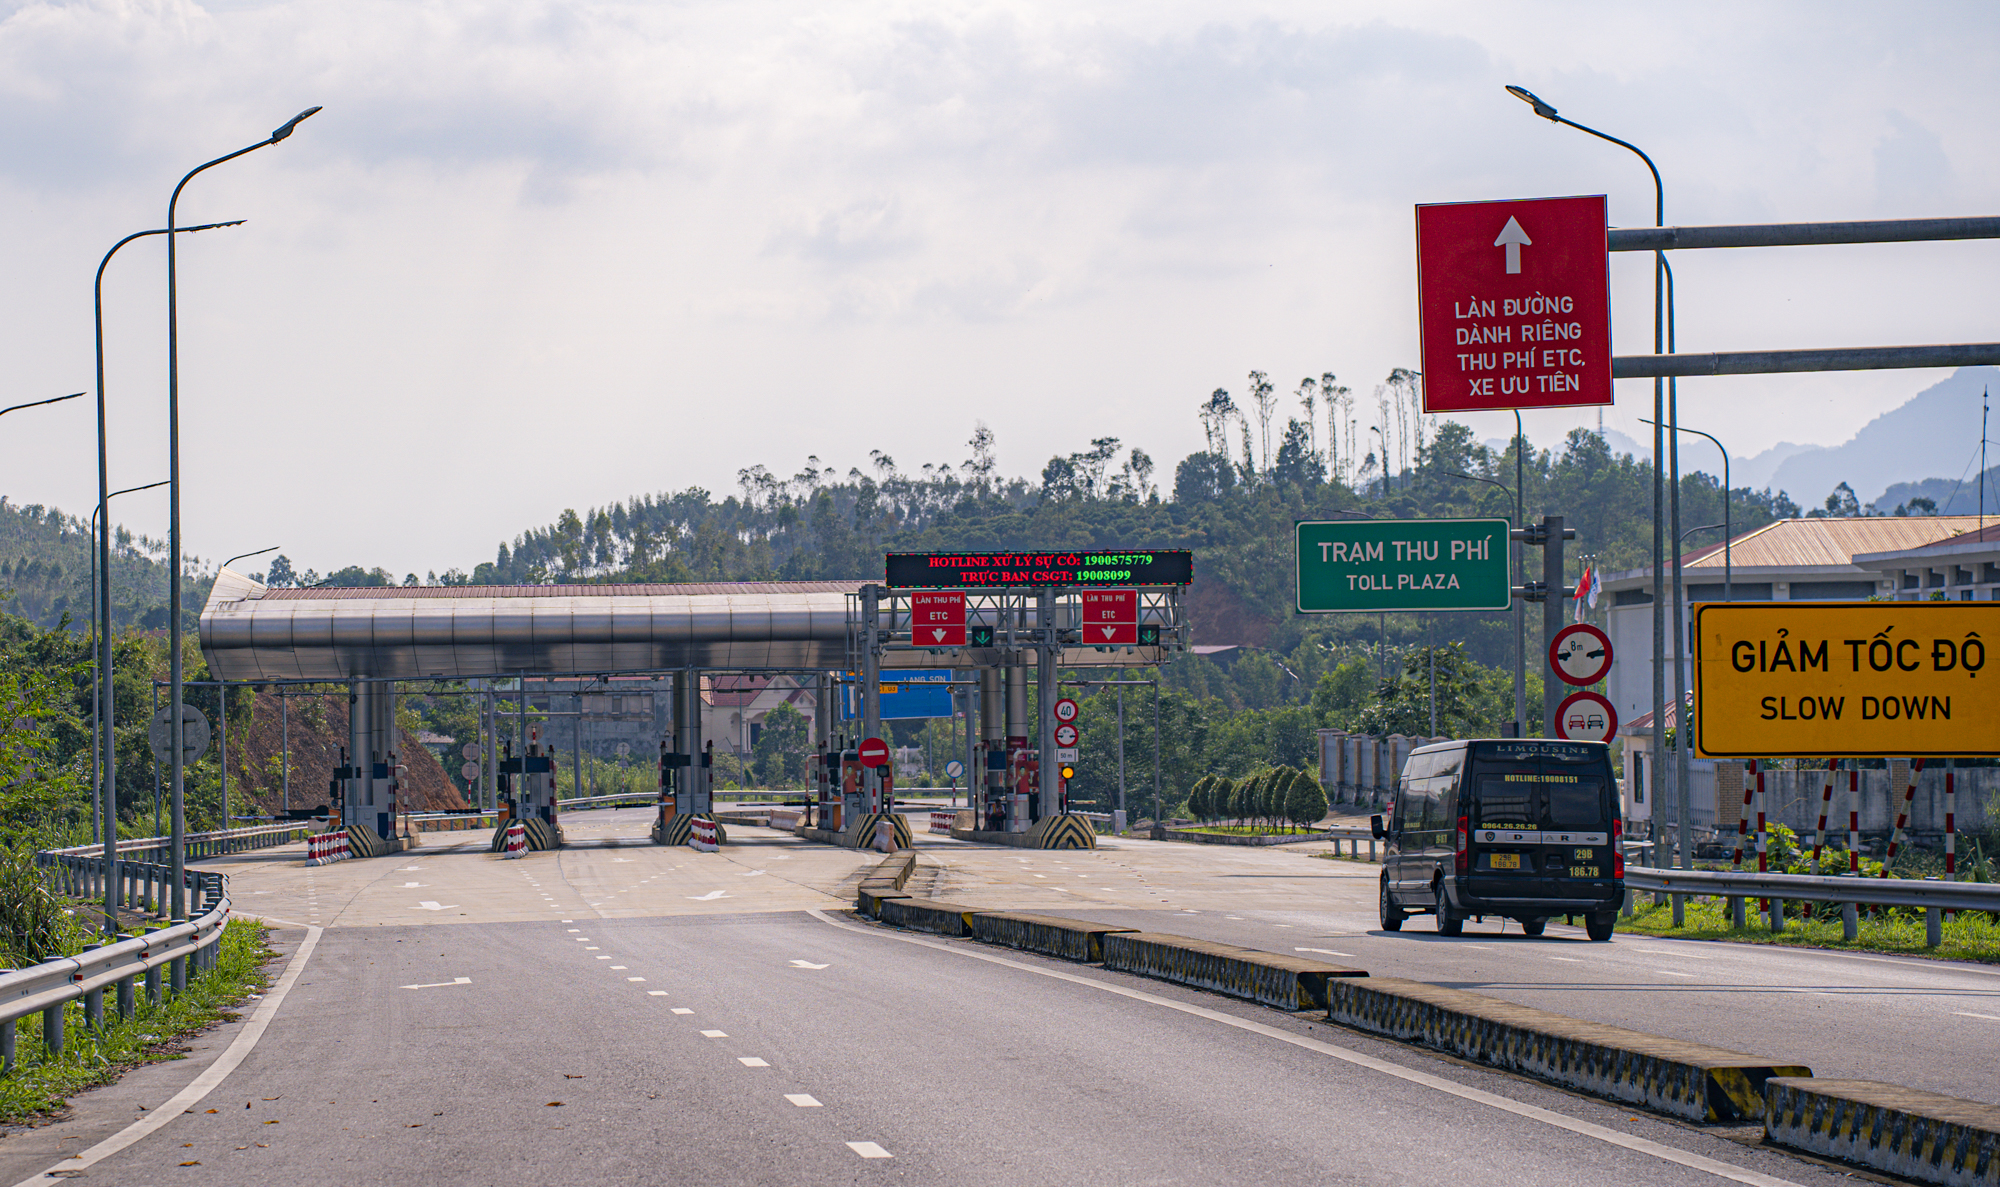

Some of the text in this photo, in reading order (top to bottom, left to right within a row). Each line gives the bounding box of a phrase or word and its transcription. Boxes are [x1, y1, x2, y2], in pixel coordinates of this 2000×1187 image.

[1455, 291, 1573, 319] LÀN ĐƯỜNG
[1456, 318, 1582, 345] DÀNH RIÊNG
[1457, 353, 1496, 371] THU
[1503, 347, 1536, 369] PHÍ
[1469, 370, 1579, 396] XE ƯU TIÊN
[1318, 535, 1492, 566] TRẠM THU PHÍ
[928, 556, 990, 567] HOTLINE
[992, 553, 1013, 566] XỬ
[1014, 554, 1033, 566] LÝ
[1035, 554, 1054, 569] SỰ
[1084, 555, 1153, 566] 1900575779
[960, 570, 1131, 585] TRỰC BAN CSGT: 19008099
[1346, 574, 1460, 591] TOLL PLAZA
[916, 595, 961, 604] LÀN THU PHÍ
[1086, 594, 1098, 602] LÀN
[1115, 593, 1126, 602] PHÍ
[930, 611, 948, 620] ETC
[1102, 610, 1116, 619] ETC
[1731, 625, 1986, 678] GIẢM TỐC ĐỘ
[1061, 705, 1072, 716] 40
[1760, 695, 1951, 720] SLOW DOWN
[1496, 745, 1589, 754] LIMOUSINE
[1482, 822, 1538, 830] 0964.26.26.26
[1576, 849, 1593, 859] 29B
[1569, 866, 1599, 877] 186.78
